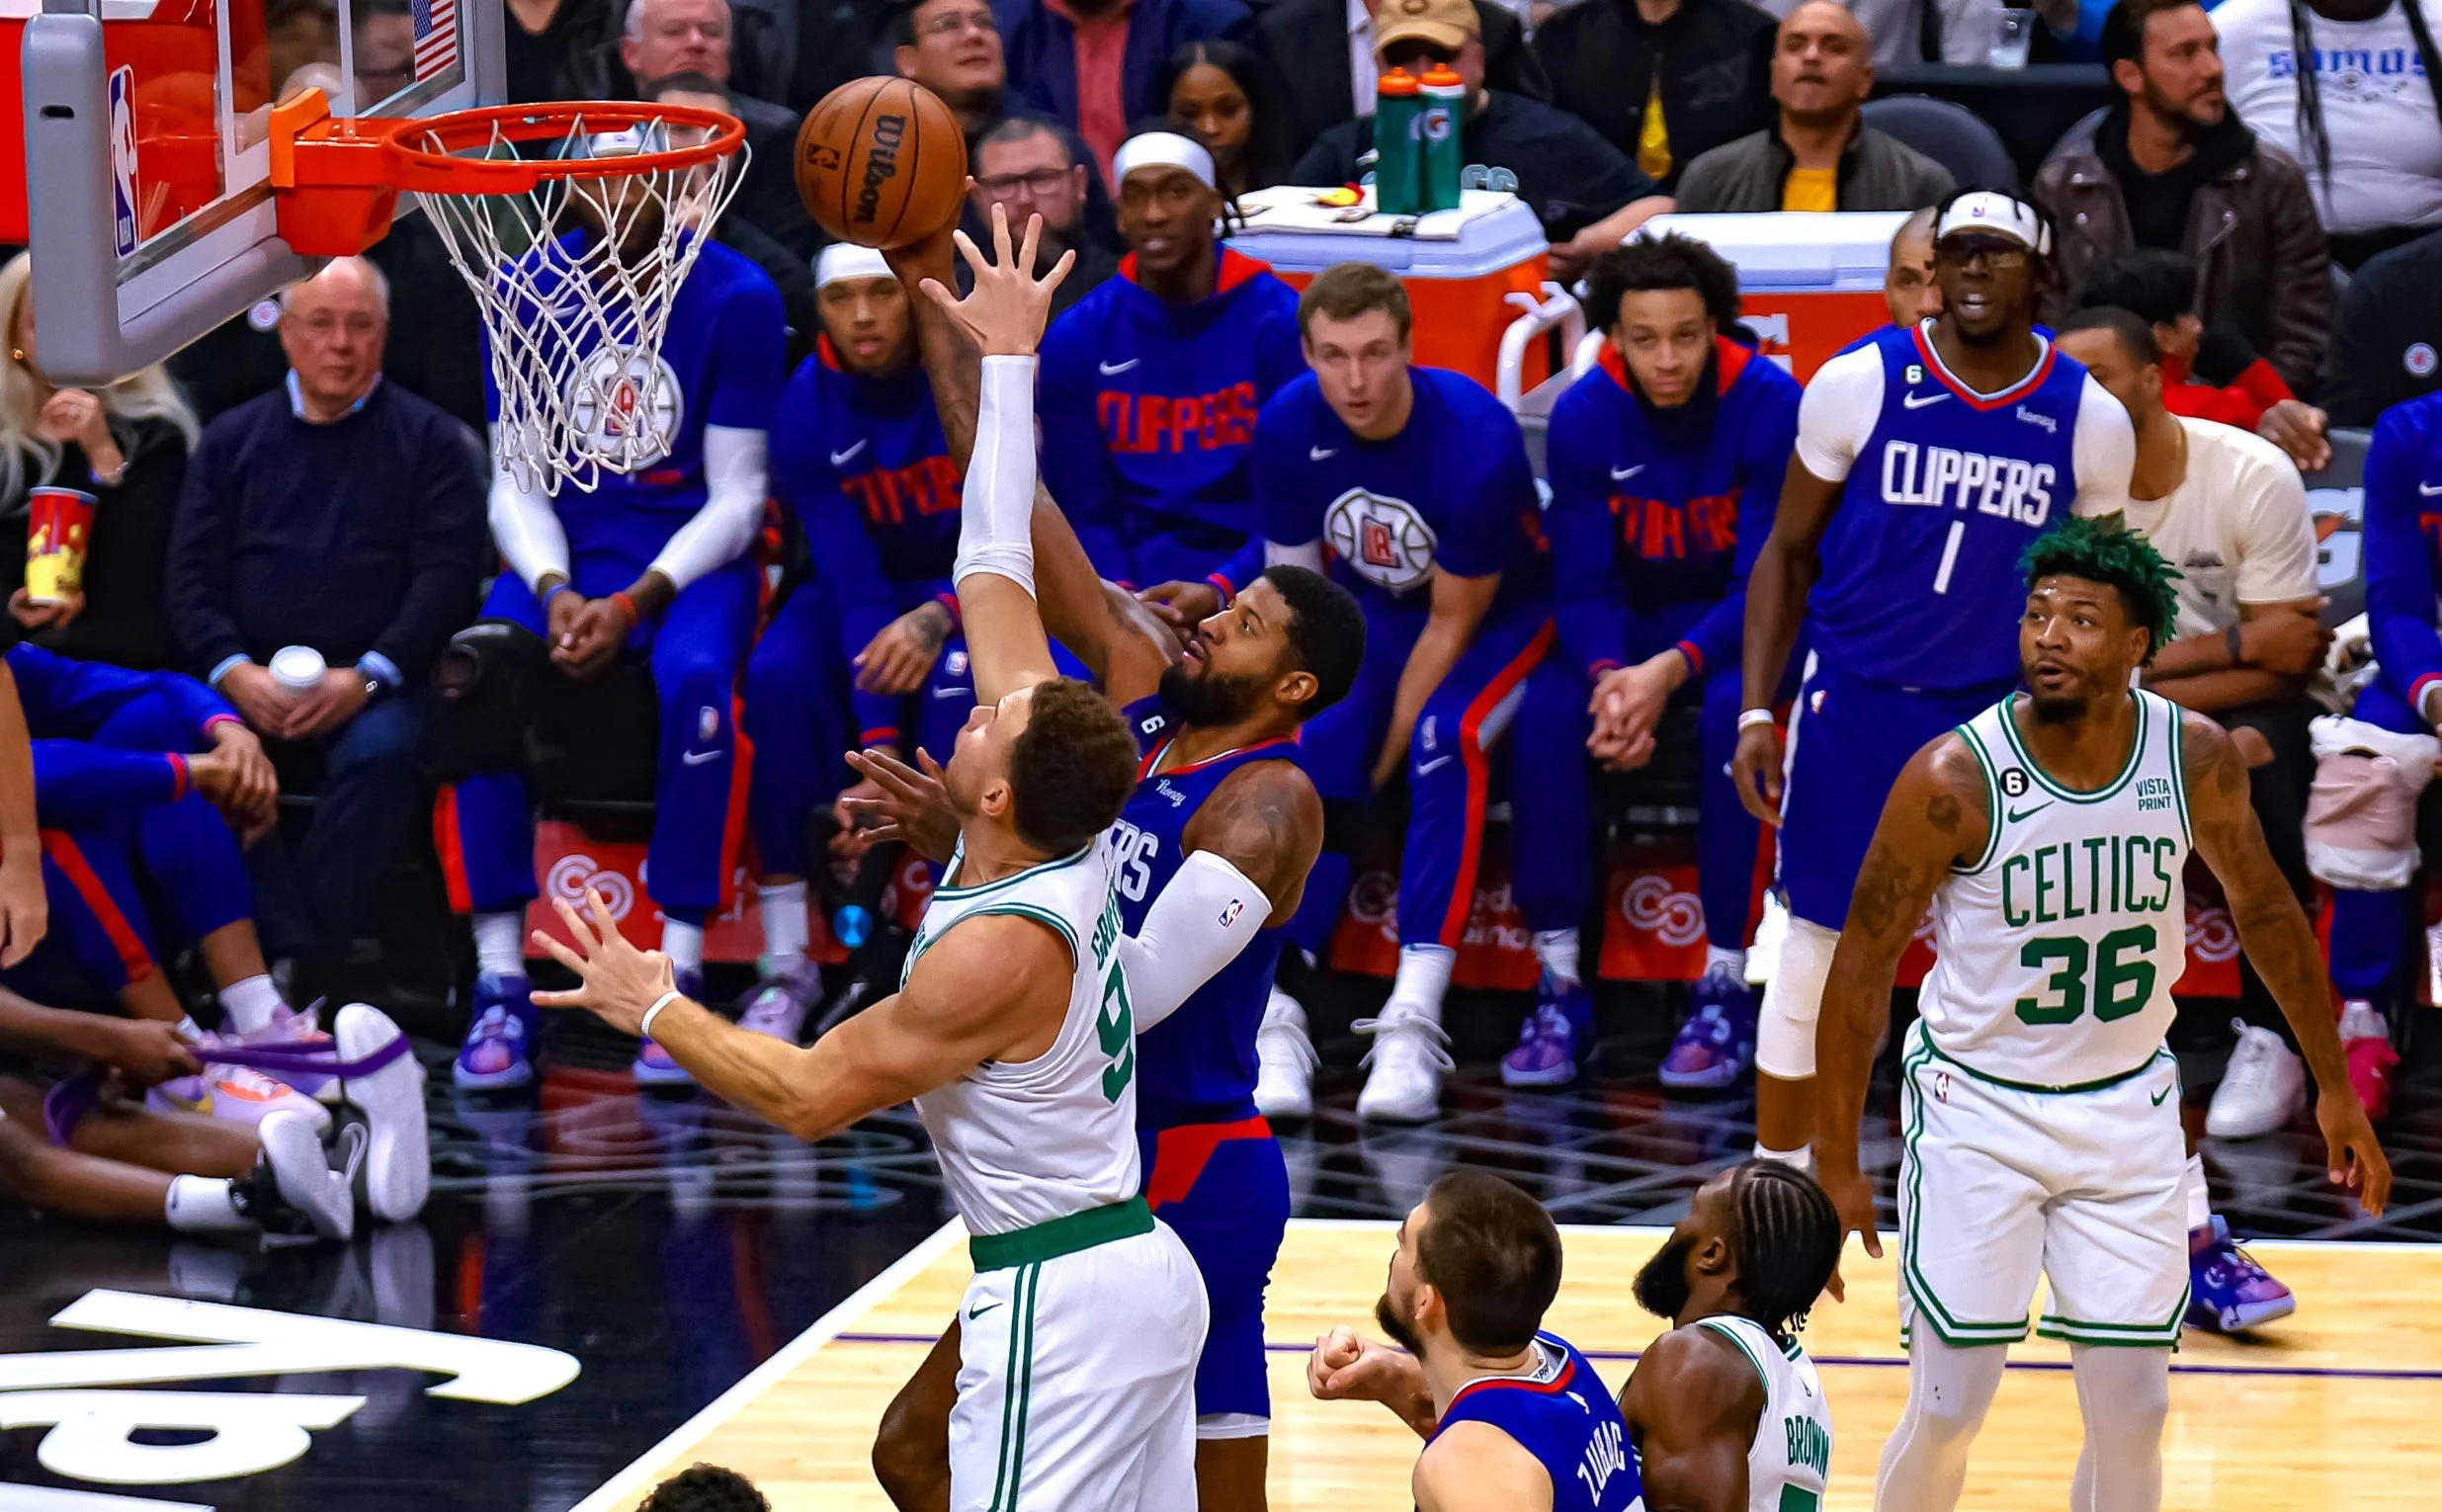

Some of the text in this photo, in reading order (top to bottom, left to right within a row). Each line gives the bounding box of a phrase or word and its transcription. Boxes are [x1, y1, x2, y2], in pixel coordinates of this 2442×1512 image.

[853, 115, 906, 222] Wilson
[1905, 366, 1923, 383] 6
[1882, 440, 2056, 528] CLIPPERS
[1933, 521, 1965, 595] 1
[1141, 714, 1165, 734] 6
[2005, 772, 2023, 795] 6
[2136, 778, 2171, 798] VISTA
[2138, 795, 2172, 812] PRINT
[2002, 835, 2176, 928] CELTICS
[2014, 923, 2157, 1026] 36
[1096, 959, 1134, 1105] 9
[1577, 1420, 1626, 1508] ZUBAC
[1784, 1414, 1829, 1480] BROWN
